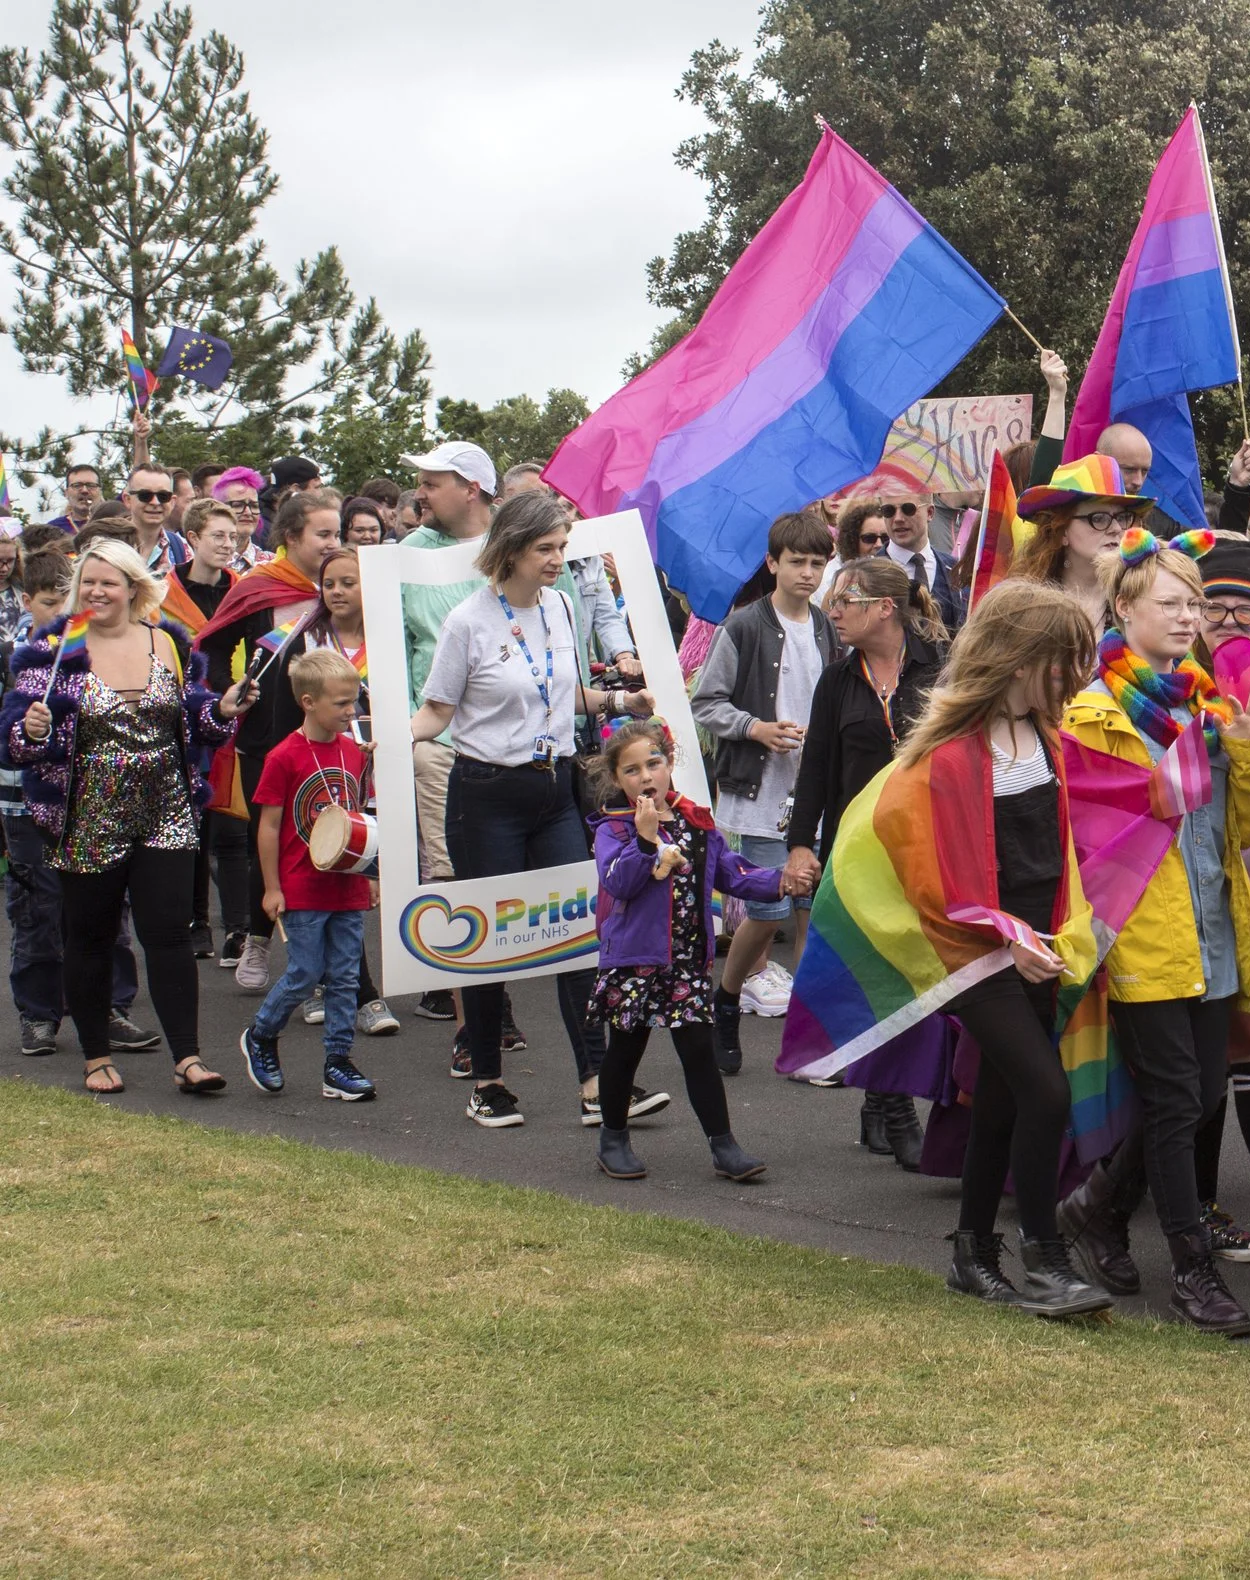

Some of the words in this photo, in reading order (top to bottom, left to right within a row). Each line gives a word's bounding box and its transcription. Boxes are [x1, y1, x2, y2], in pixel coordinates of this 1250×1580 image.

[495, 935, 507, 946] in
[513, 931, 536, 944] our
[541, 924, 569, 939] NHS
